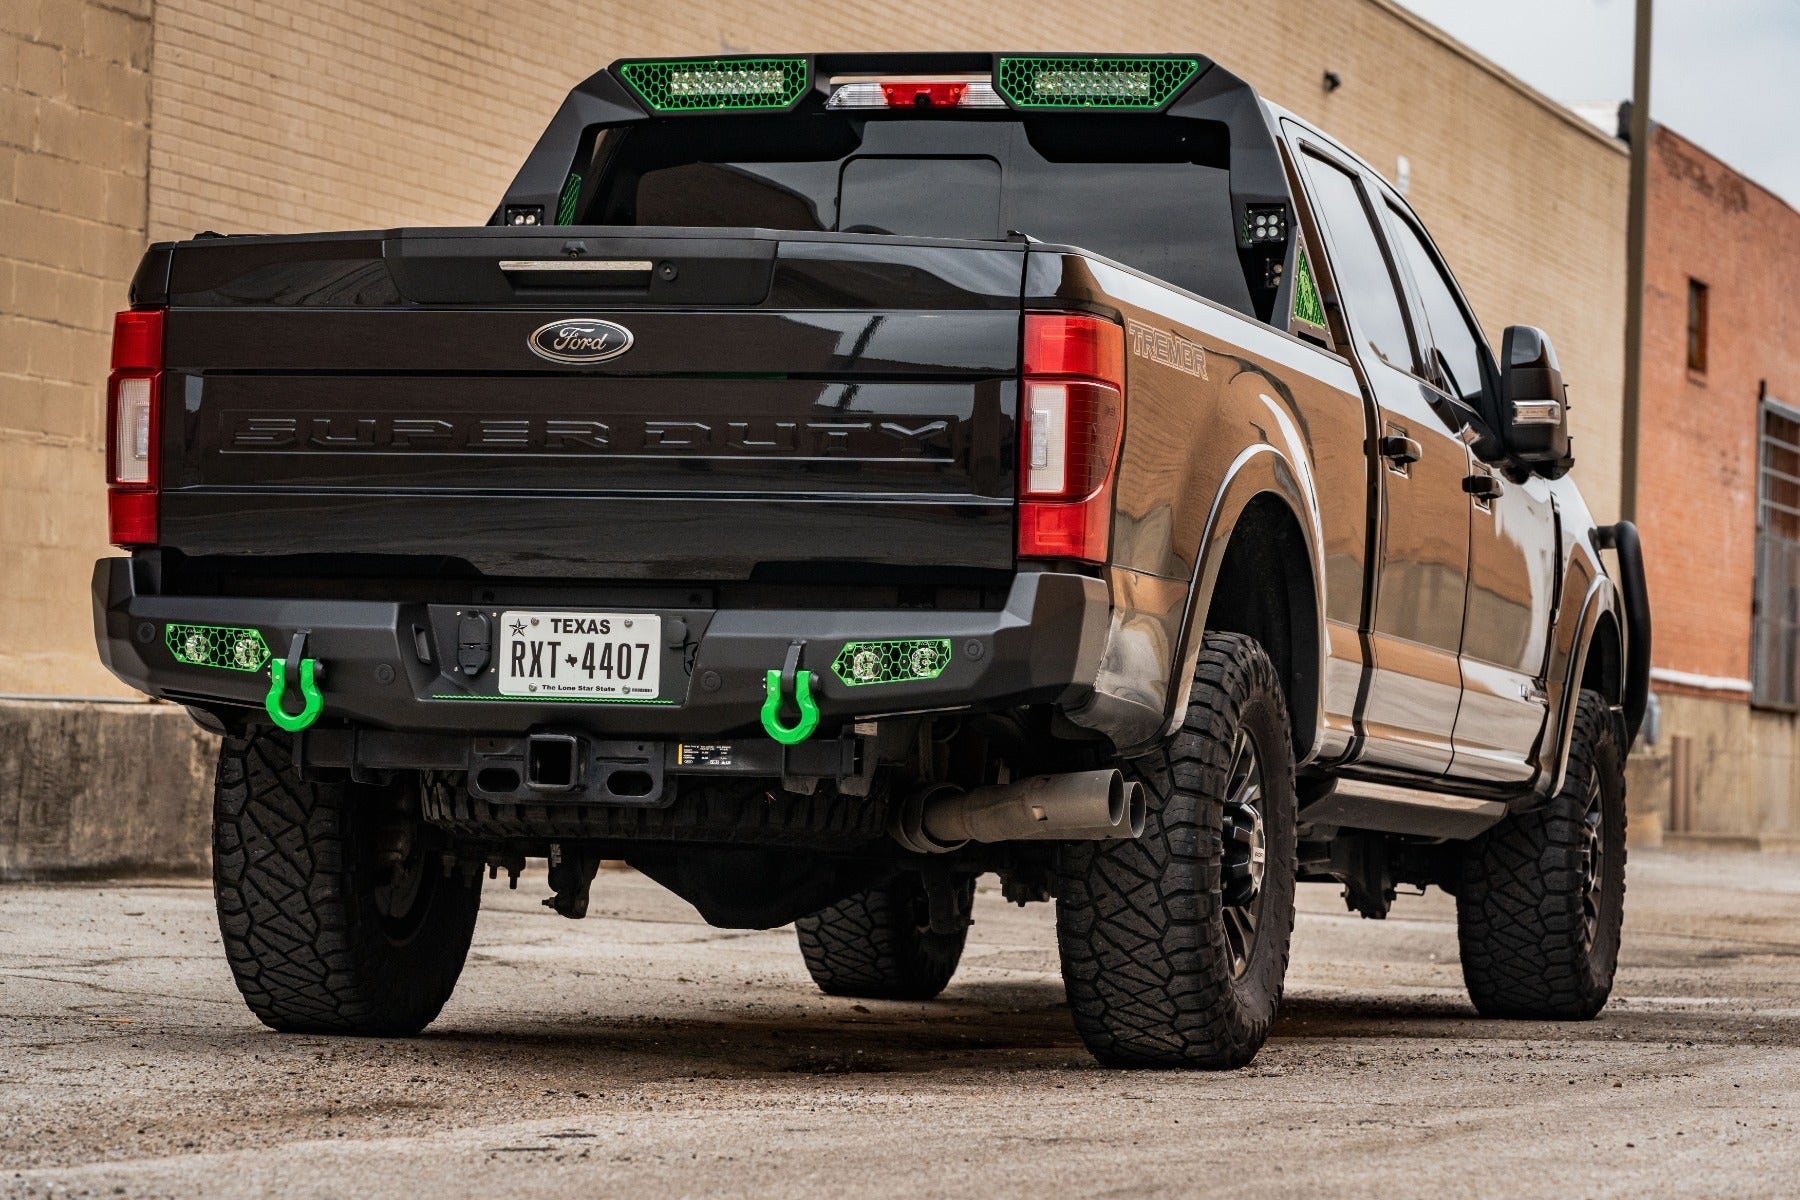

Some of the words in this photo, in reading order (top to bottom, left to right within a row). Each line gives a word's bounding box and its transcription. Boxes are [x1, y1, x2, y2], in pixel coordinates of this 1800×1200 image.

[553, 327, 609, 350] Ford
[1128, 318, 1209, 381] TREMOR
[233, 418, 609, 448] SUPER
[643, 421, 949, 451] DUTY
[551, 618, 611, 635] TEXAS
[511, 640, 561, 678] RXT
[581, 642, 650, 680] 4407
